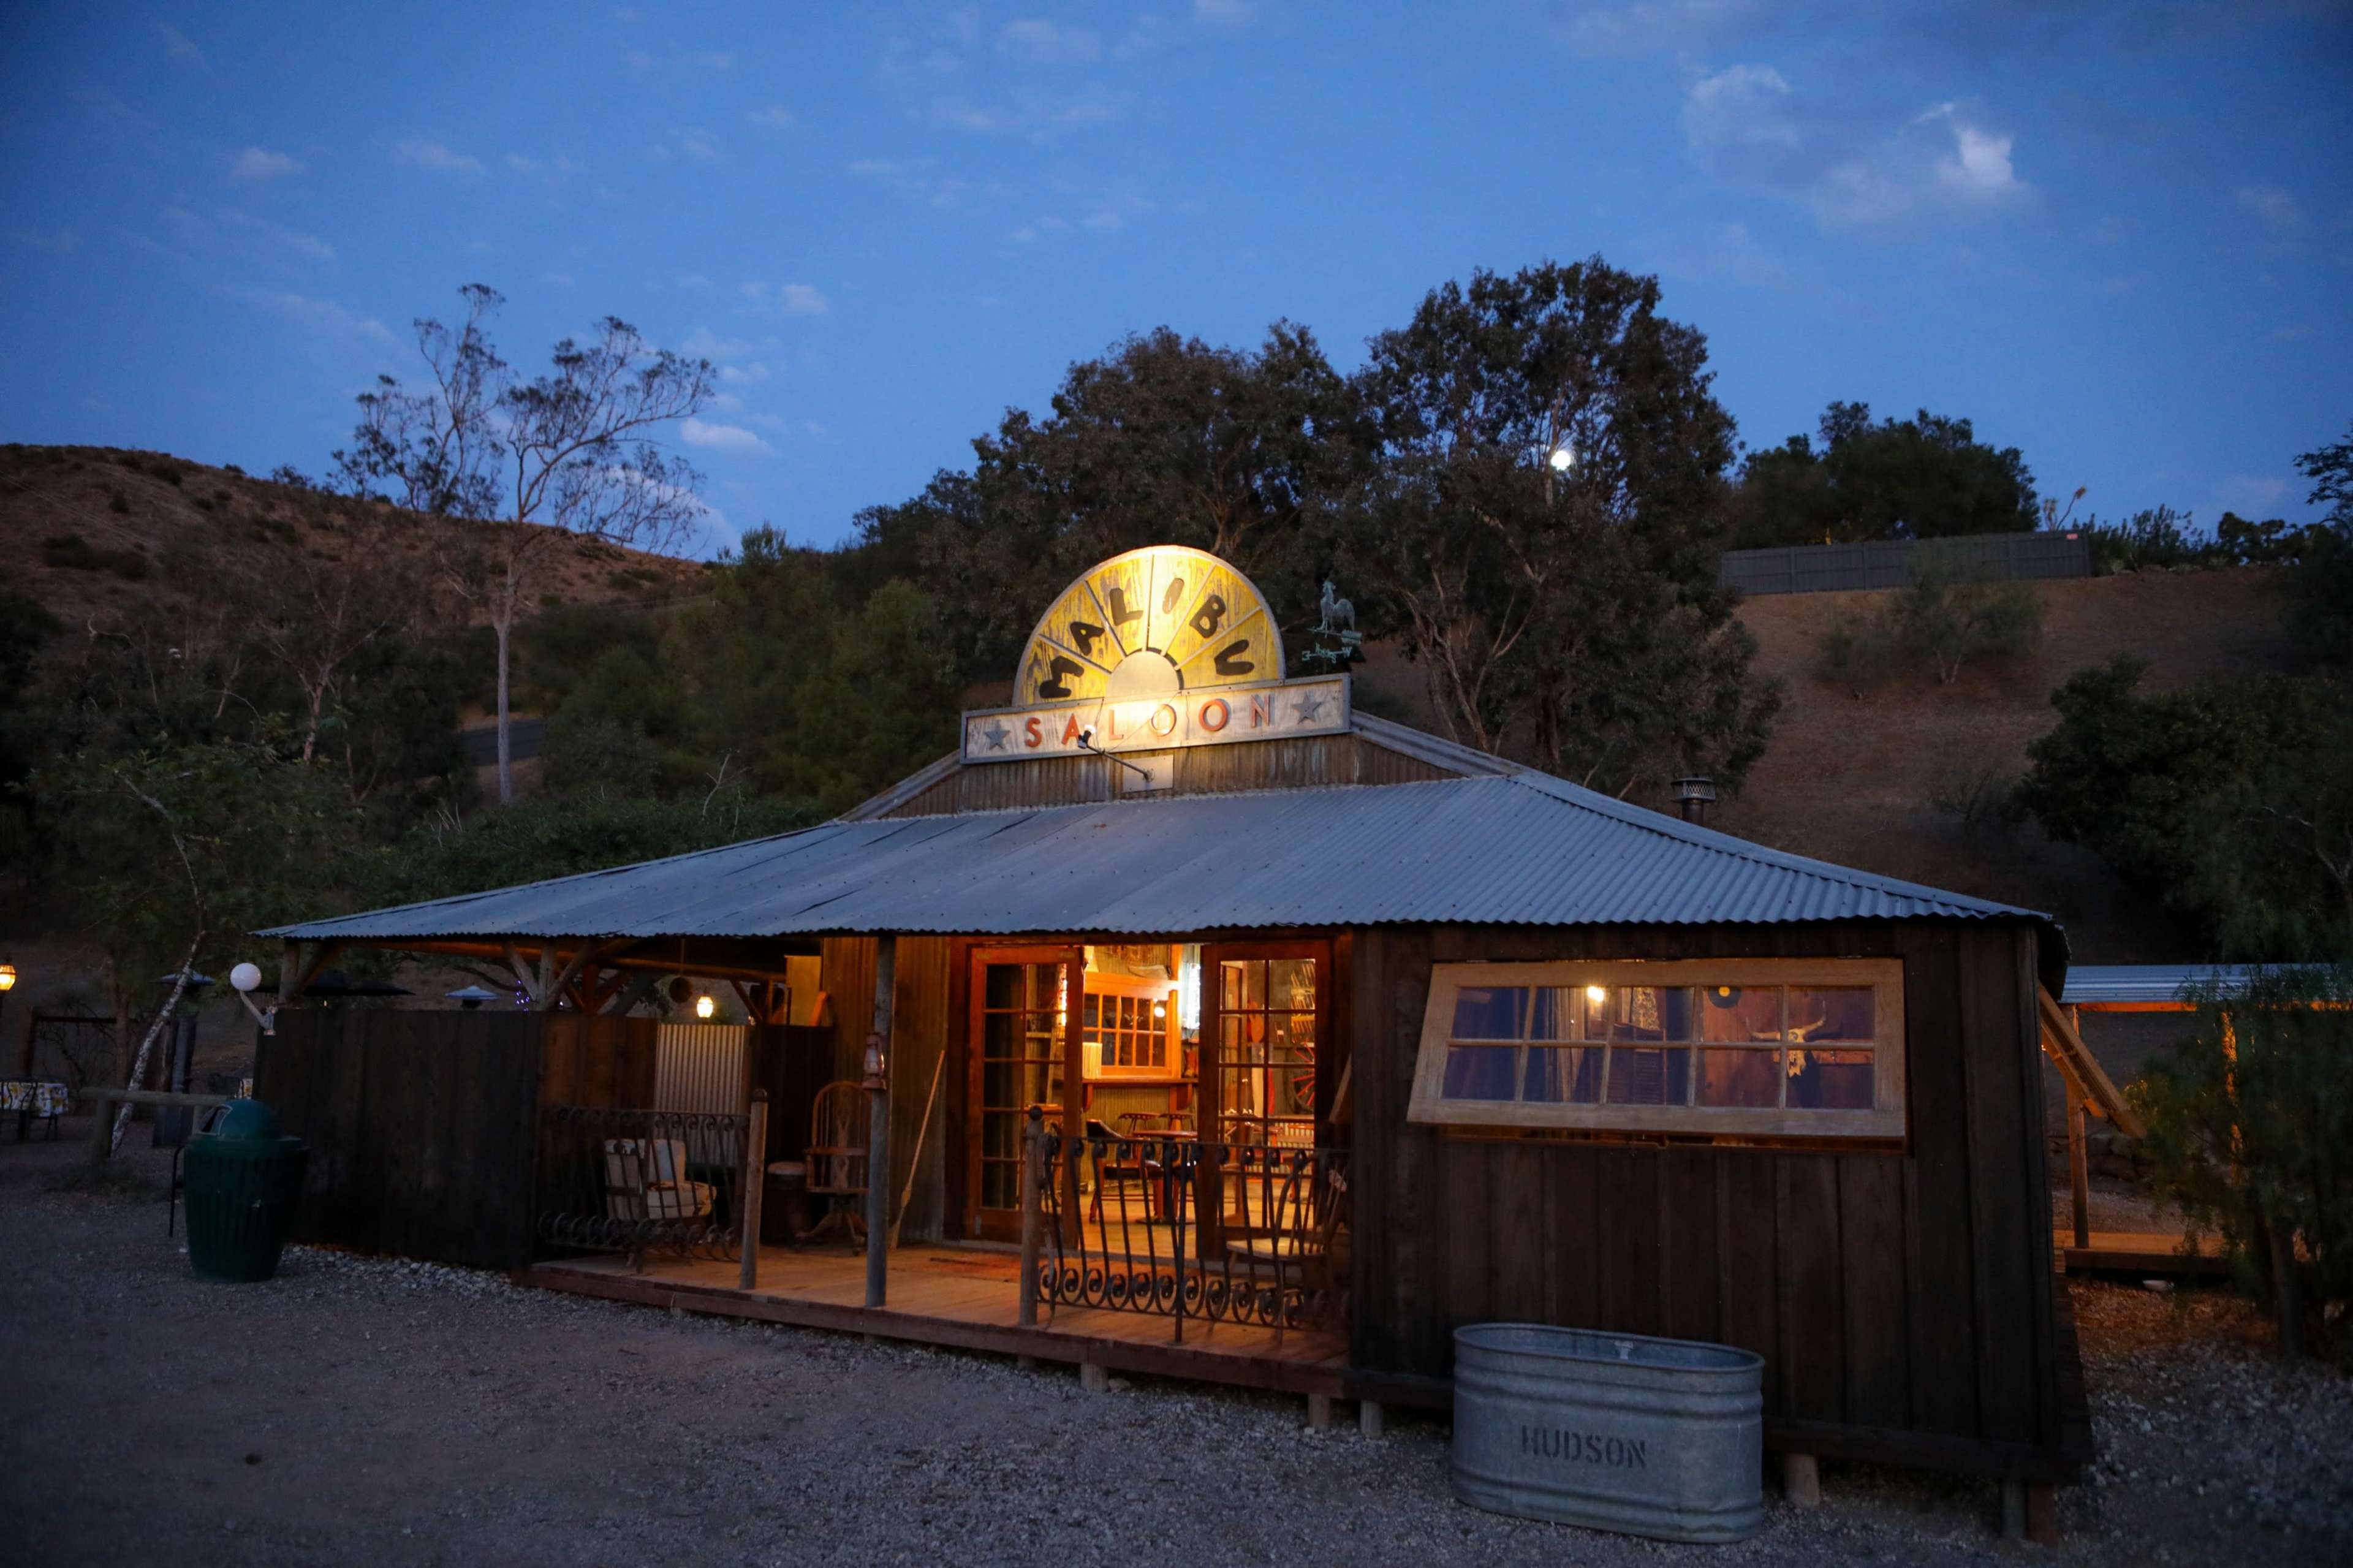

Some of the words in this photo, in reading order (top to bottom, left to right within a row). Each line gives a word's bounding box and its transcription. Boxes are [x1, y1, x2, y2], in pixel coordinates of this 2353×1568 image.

[1039, 578, 1255, 699] MALIBU
[1025, 694, 1270, 748] SALOON
[1521, 1425, 1646, 1469] HUDSON
